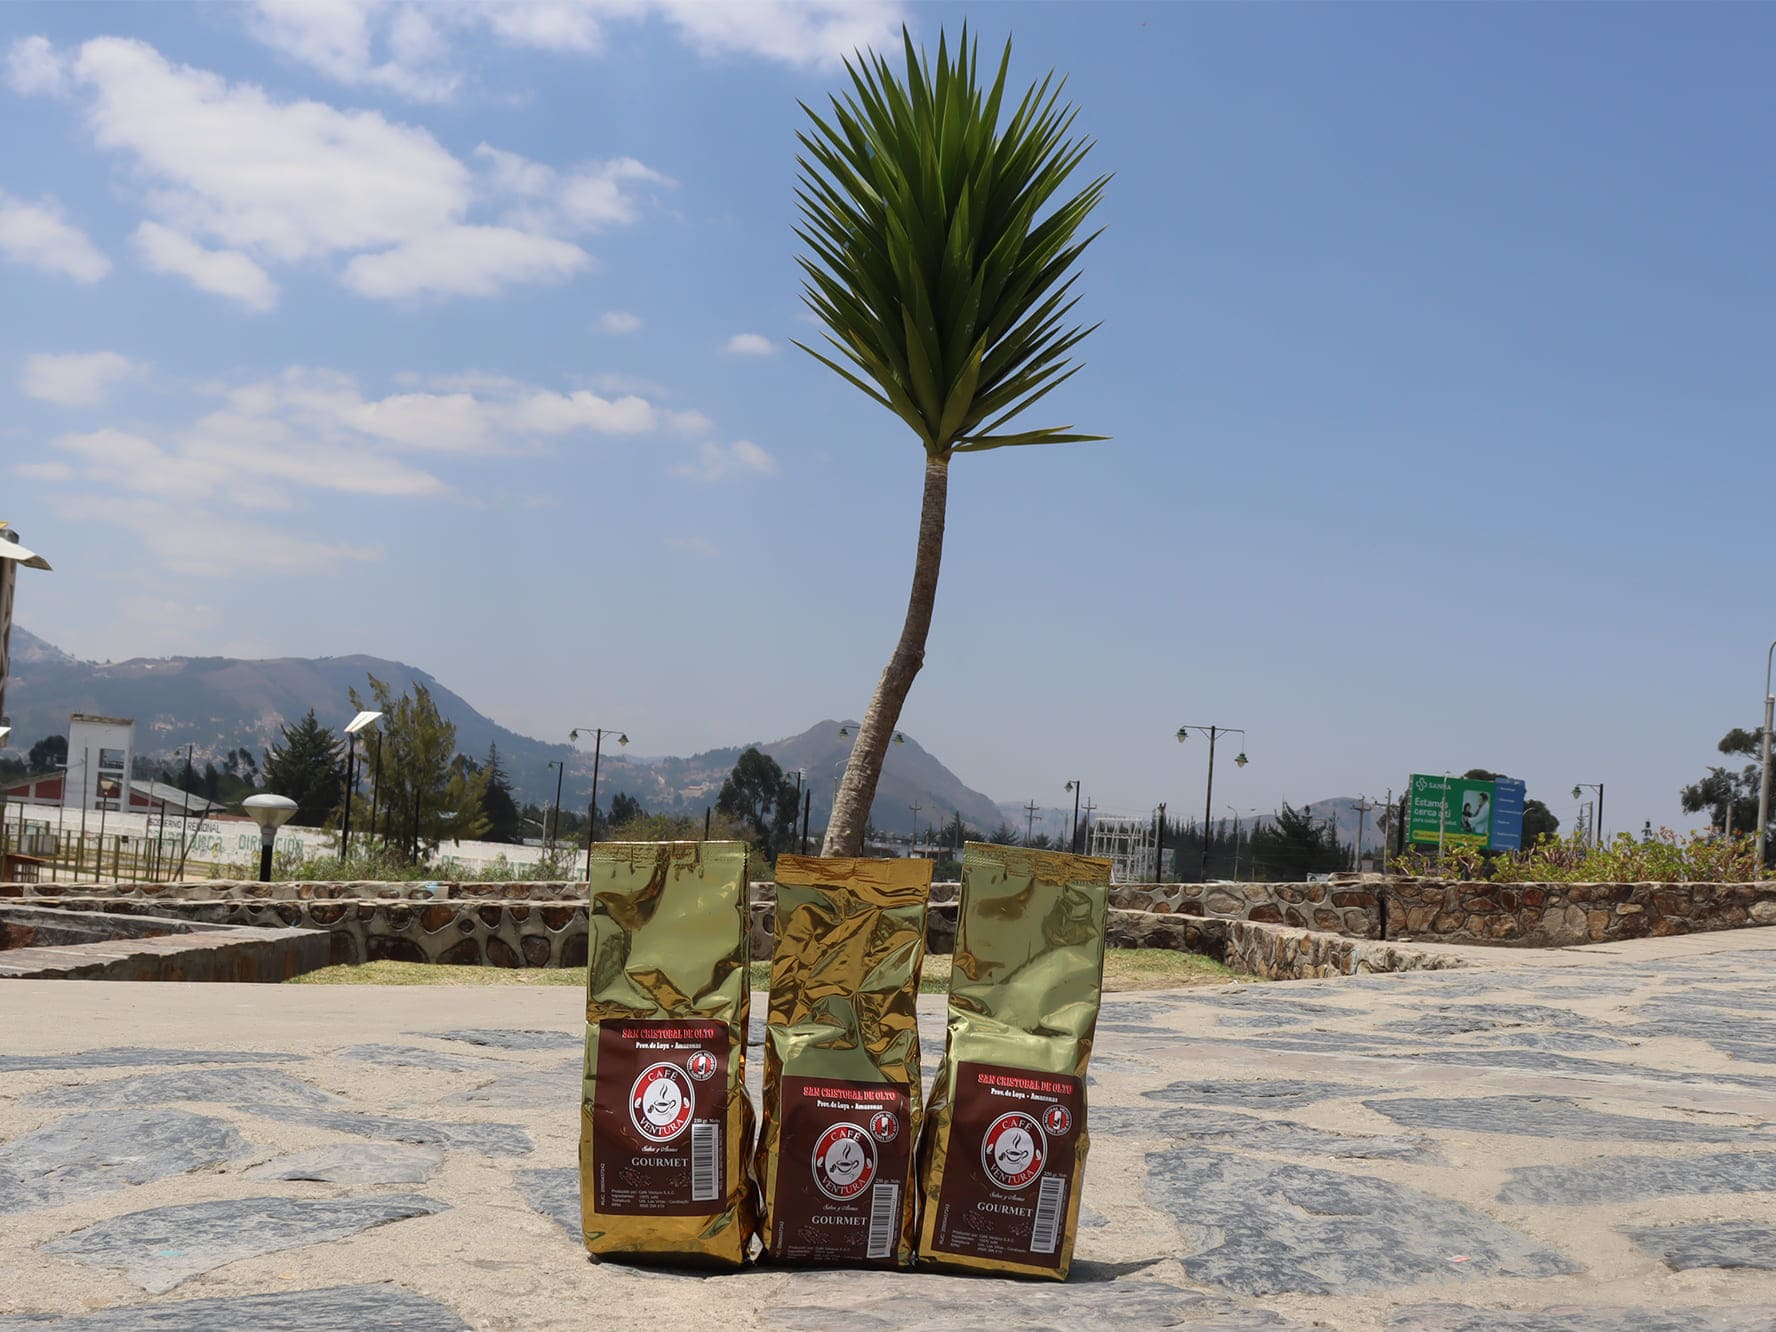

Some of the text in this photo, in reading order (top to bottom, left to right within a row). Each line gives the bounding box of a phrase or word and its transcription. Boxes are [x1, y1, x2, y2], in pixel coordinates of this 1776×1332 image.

[1414, 809, 1437, 817] cerca
[148, 818, 220, 834] GOBERNO REIONAL
[622, 1028, 638, 1038] SAN
[640, 1028, 682, 1038] CRISTOBAL
[684, 1029, 694, 1038] DE
[648, 1070, 678, 1081] CAFÉ
[978, 1074, 995, 1084] SAN
[996, 1076, 1040, 1090] CRISTOBAL
[1041, 1082, 1052, 1092] DE
[803, 1086, 820, 1096] SAN
[821, 1088, 864, 1100] CRISTOBAL
[864, 1090, 874, 1100] DE
[640, 1117, 684, 1136] VENTURA
[1002, 1120, 1032, 1132] CAFÉ
[830, 1130, 861, 1141] CAFÉ
[632, 1158, 688, 1168] GOURMET
[990, 1163, 1034, 1184] VENTURA
[822, 1176, 866, 1194] VENTURA
[977, 1202, 1032, 1217] GOURMET
[812, 1216, 867, 1226] GOURMET
